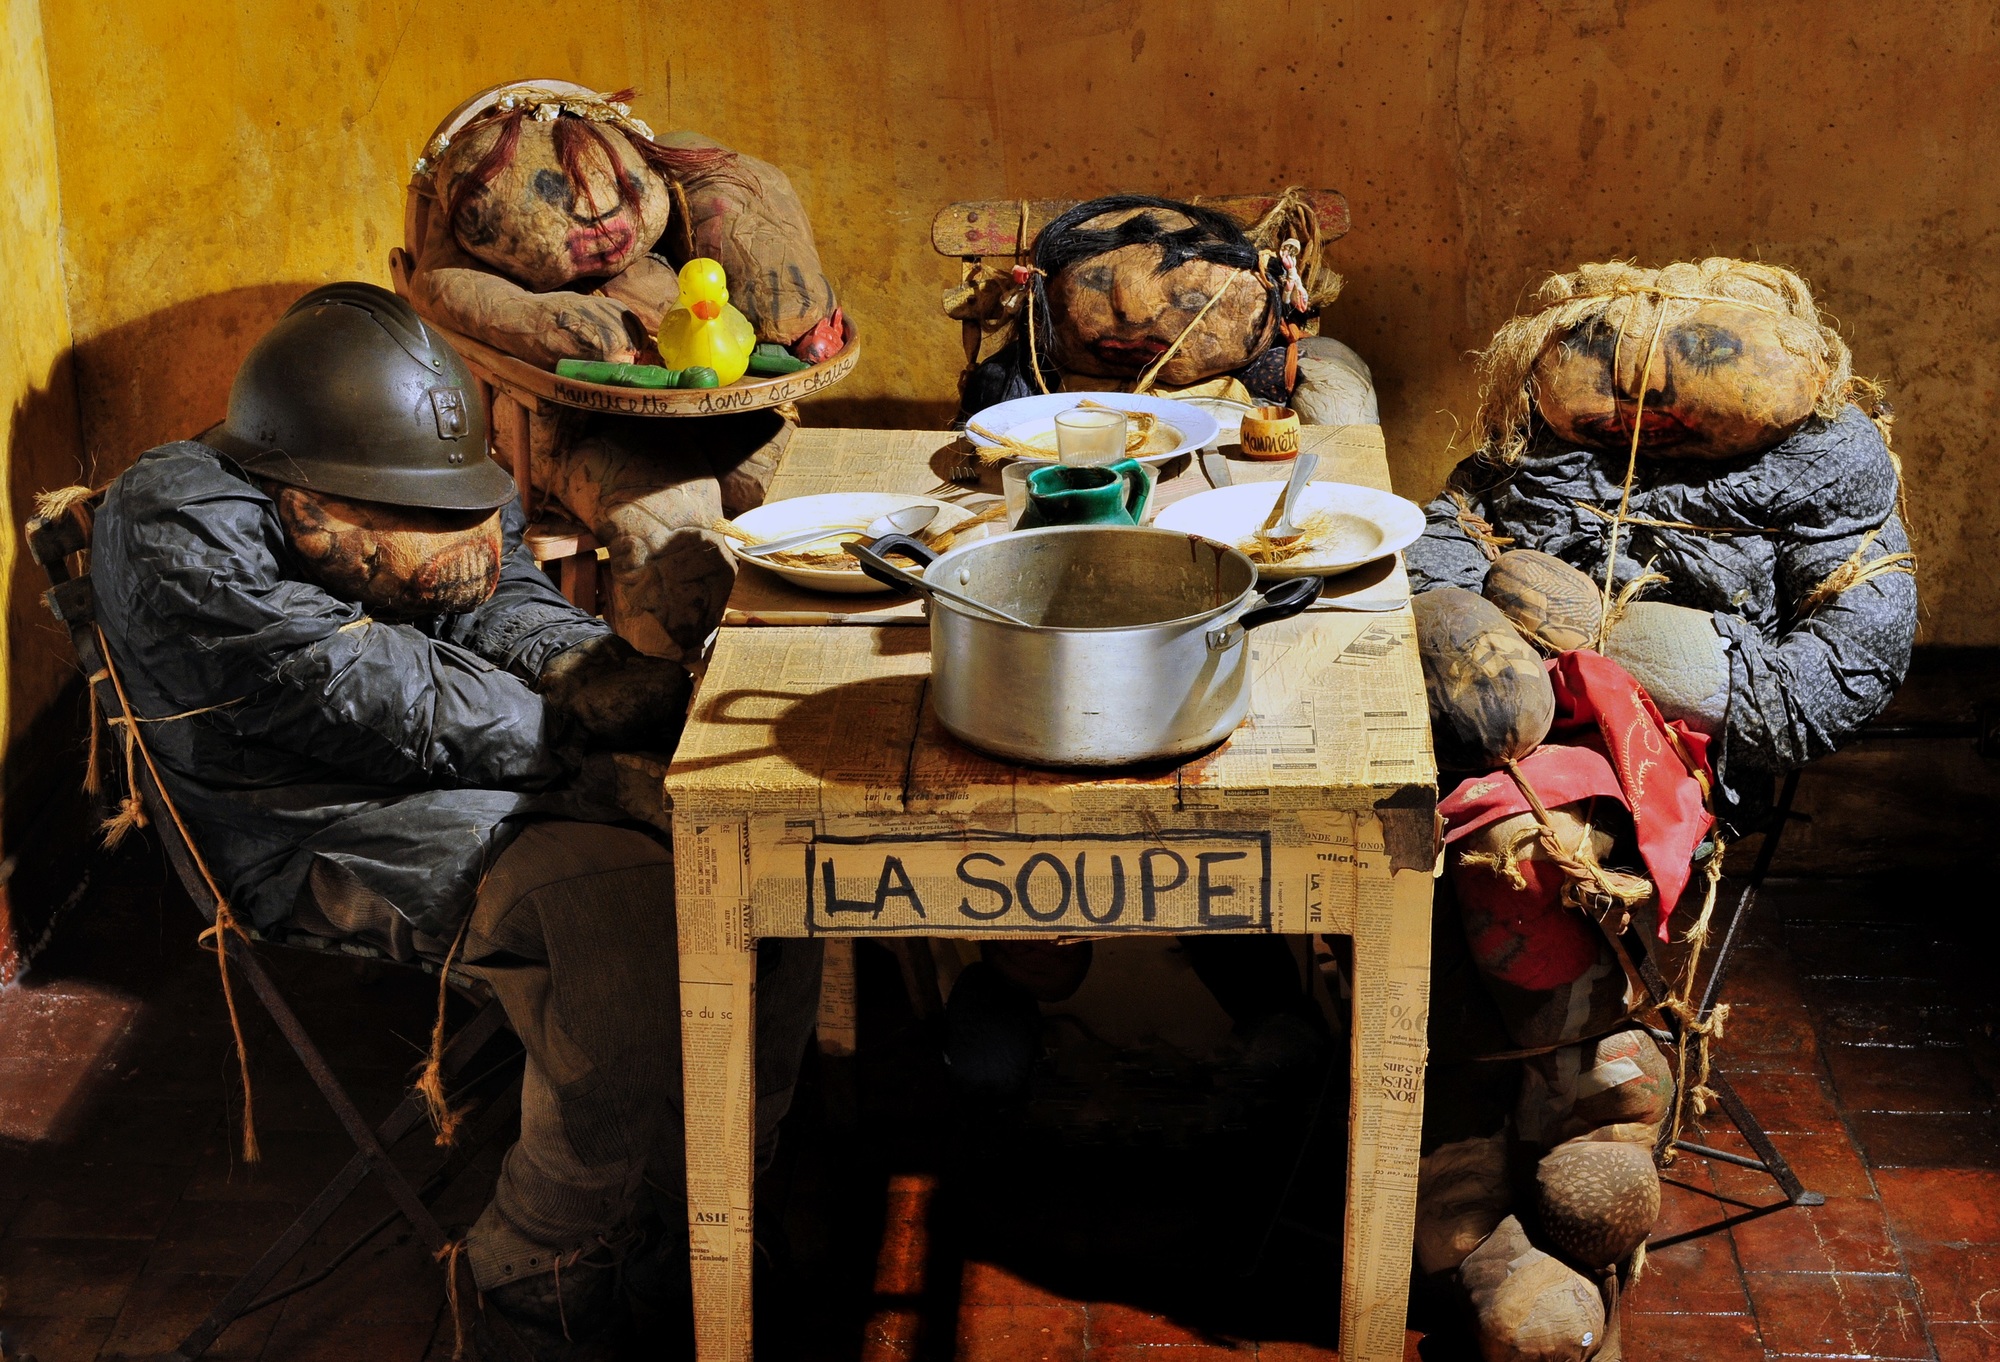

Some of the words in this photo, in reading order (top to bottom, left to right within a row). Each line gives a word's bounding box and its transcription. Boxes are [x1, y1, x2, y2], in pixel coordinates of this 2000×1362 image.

[555, 384, 676, 415] Mauricette
[698, 388, 753, 415] dans
[768, 384, 796, 401] sa
[803, 358, 853, 391] chaise
[822, 856, 926, 919] LA
[956, 849, 1254, 925] SOUPE
[1310, 873, 1320, 891] LA
[1310, 902, 1322, 923] VIE
[699, 1006, 714, 1019] du
[720, 1011, 733, 1020] sc
[1383, 1061, 1404, 1072] ans
[1404, 1065, 1414, 1076] 5
[695, 1212, 729, 1223] ASIE
